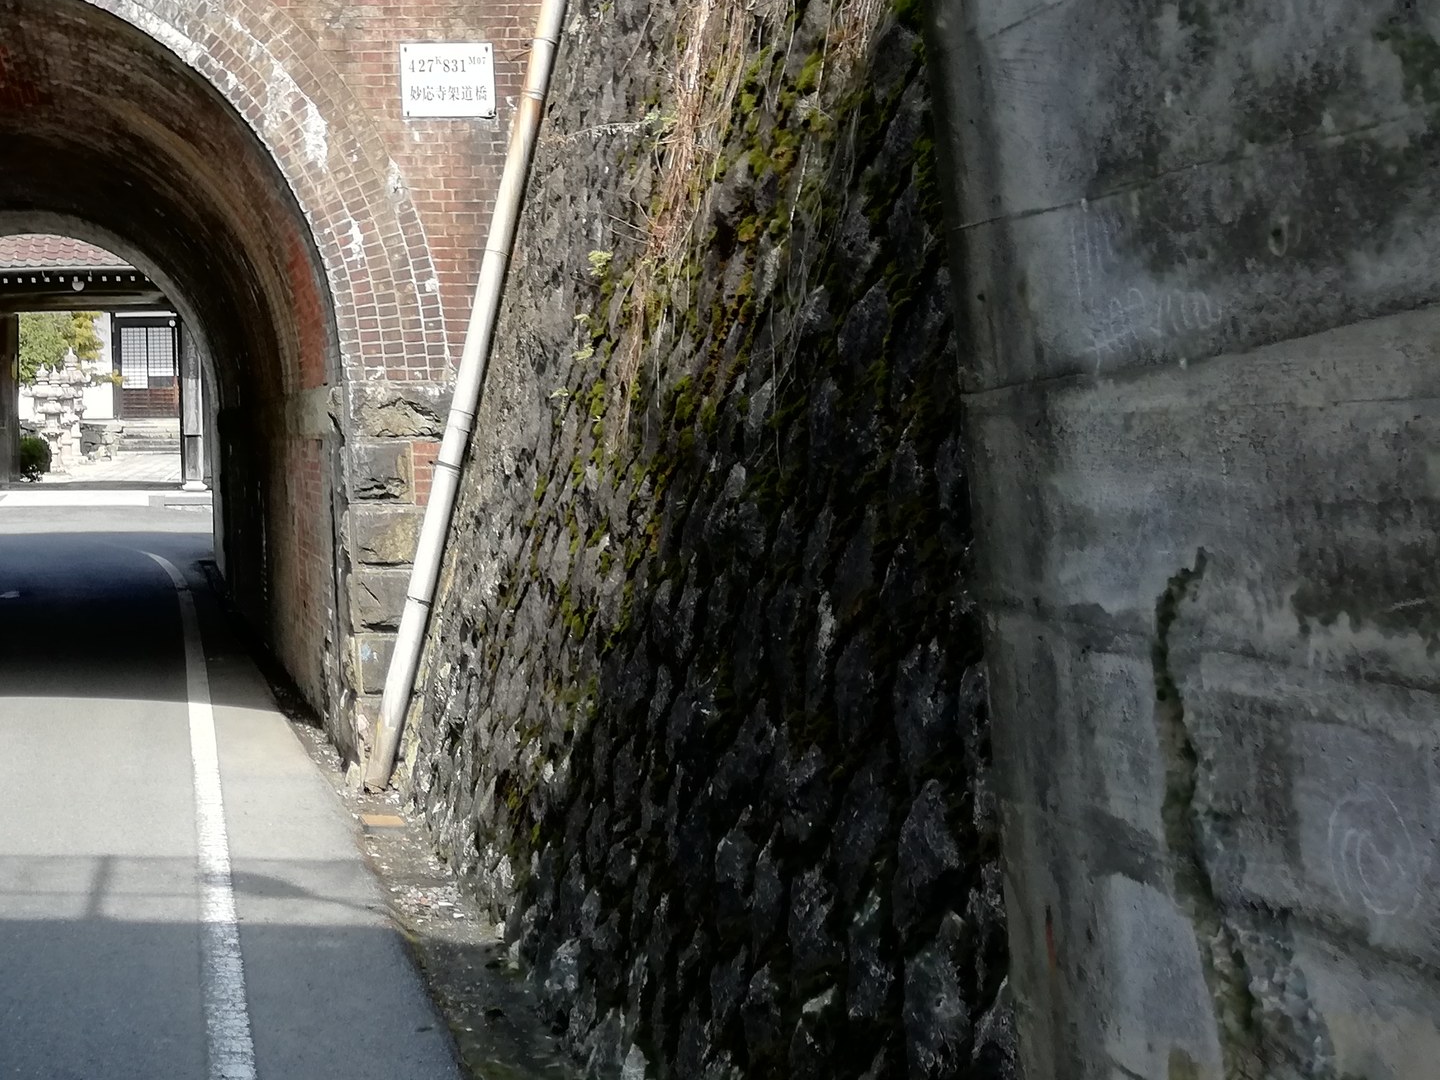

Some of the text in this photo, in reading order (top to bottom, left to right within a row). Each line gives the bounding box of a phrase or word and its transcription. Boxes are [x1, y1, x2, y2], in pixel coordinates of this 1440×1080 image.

[410, 85, 487, 102] 妙応寺架道橋
